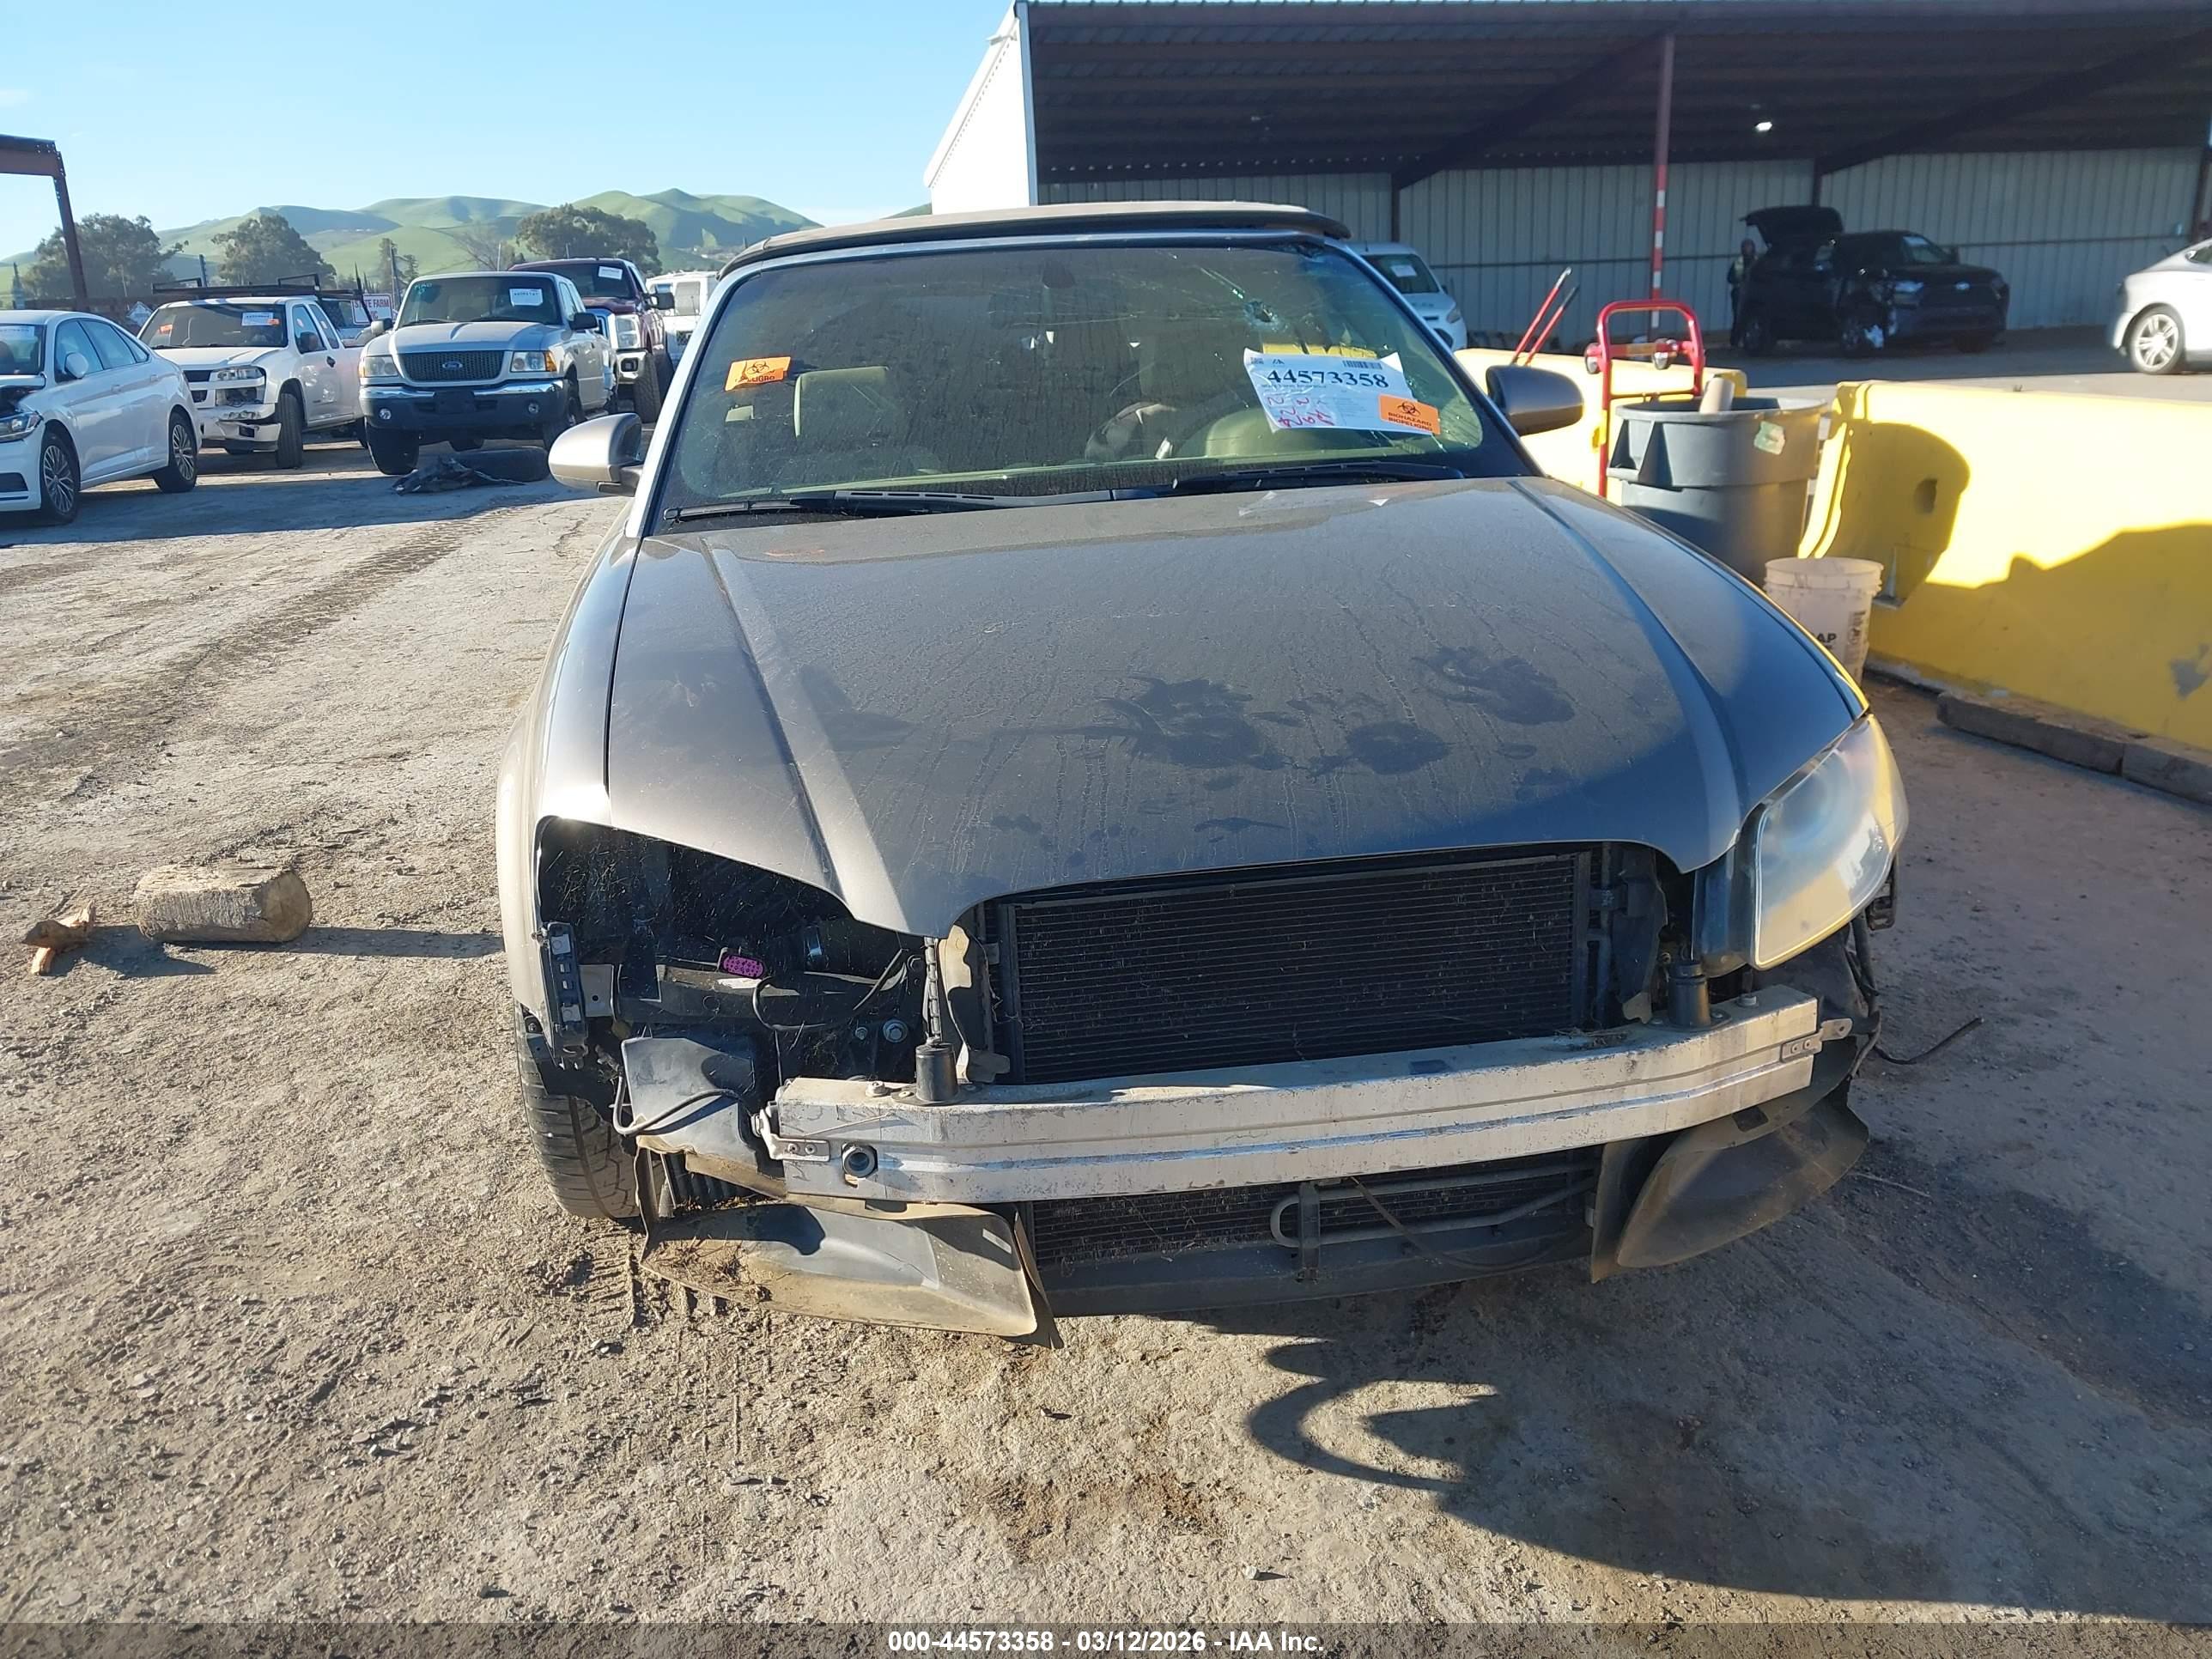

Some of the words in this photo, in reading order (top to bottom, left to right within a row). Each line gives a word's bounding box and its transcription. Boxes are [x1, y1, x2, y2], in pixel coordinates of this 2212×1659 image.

[355, 299, 372, 308] STTE
[1267, 369, 1389, 389] 44573358
[1388, 411, 1432, 426] BIOHAZARD
[1388, 416, 1433, 432] BIOPELIGRO
